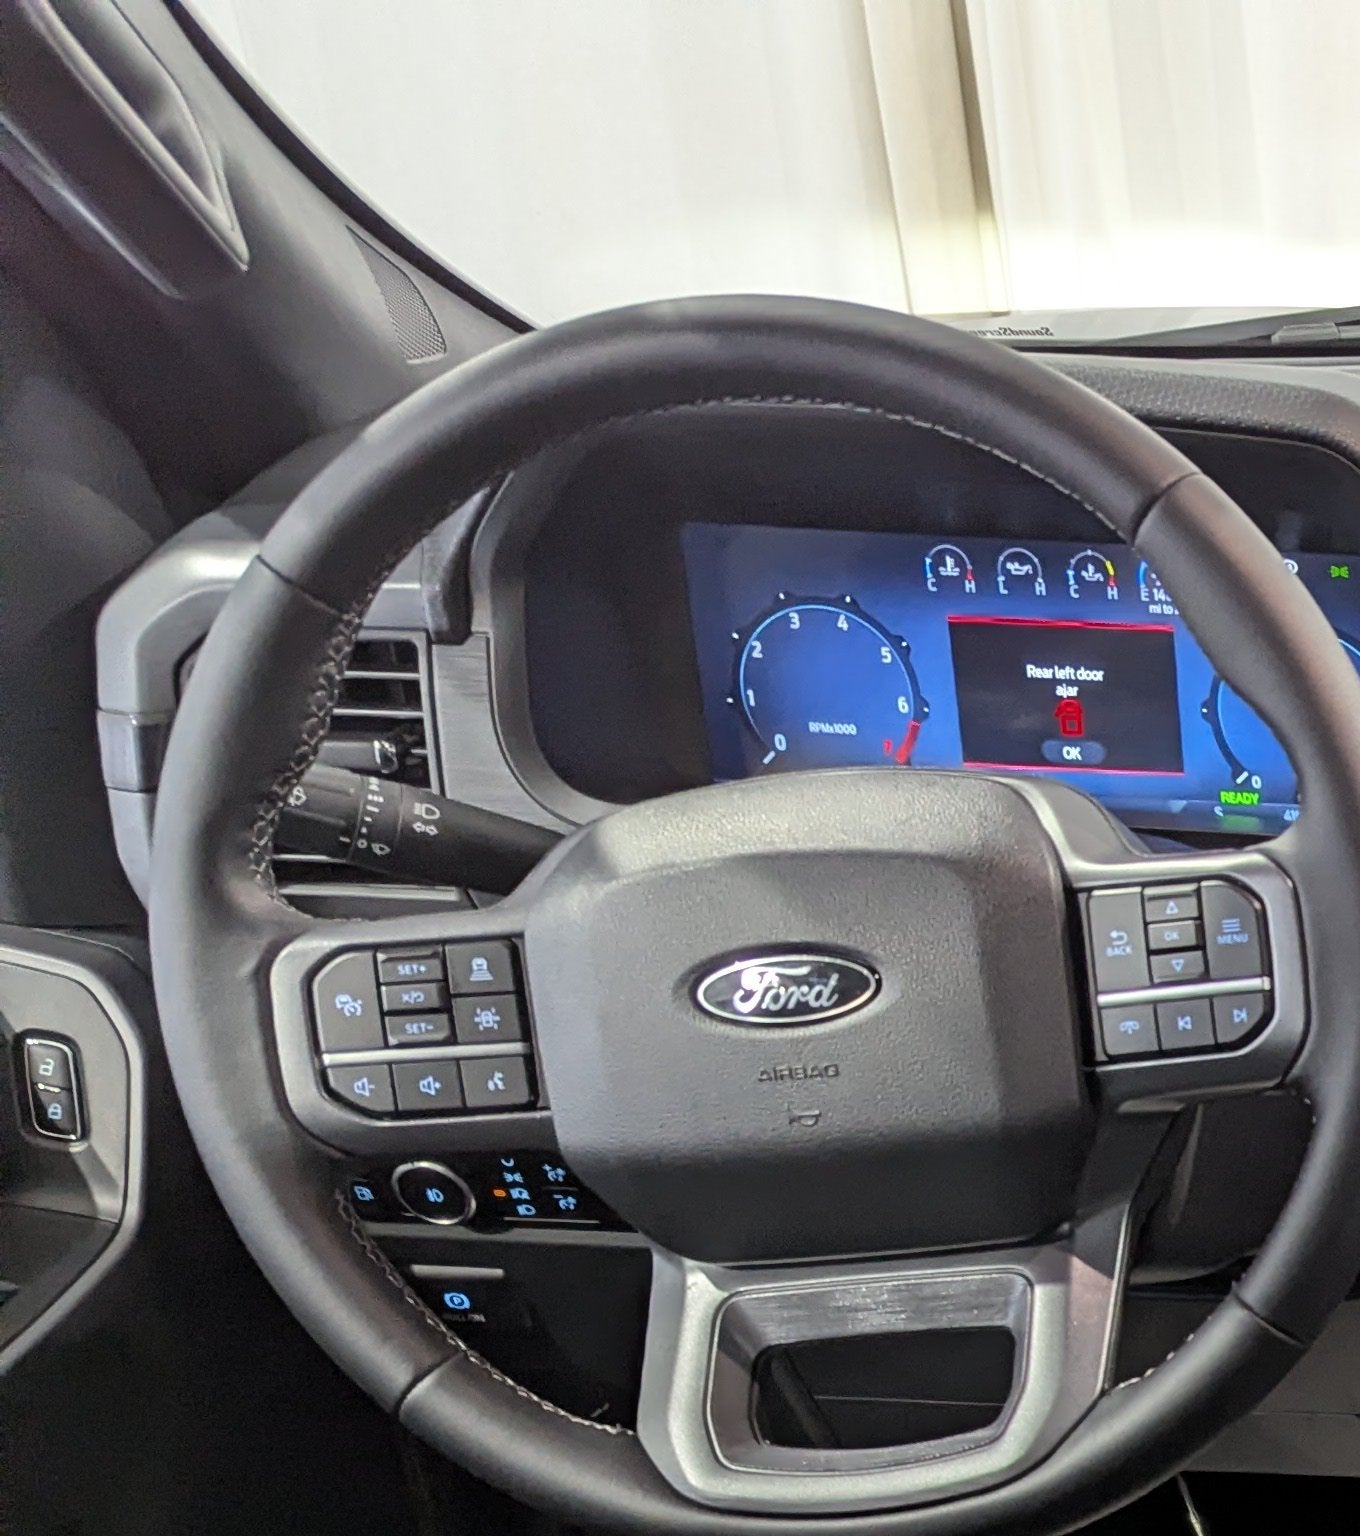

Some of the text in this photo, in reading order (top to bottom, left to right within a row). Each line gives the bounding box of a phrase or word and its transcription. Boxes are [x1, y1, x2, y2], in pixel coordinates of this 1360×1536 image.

[927, 578, 937, 592] C
[965, 580, 976, 593] H
[1035, 582, 1046, 596] H
[1069, 586, 1079, 598] C
[1107, 586, 1118, 600] H
[789, 612, 800, 629] 3
[837, 614, 848, 631] 4
[751, 641, 763, 658] 2
[881, 647, 892, 664] 5
[1026, 664, 1105, 681] Rear left door
[1055, 683, 1079, 698] ajar
[747, 689, 755, 707] 1
[897, 696, 909, 714] 6
[774, 733, 787, 751] 0
[1062, 746, 1082, 760] OK
[1251, 775, 1262, 789] 0
[1220, 791, 1260, 805] READY
[1163, 931, 1180, 941] OK
[1215, 933, 1249, 945] MENU
[1106, 945, 1133, 957] BACK
[732, 965, 840, 1014] Ford
[758, 1063, 841, 1083] AIRBAG
